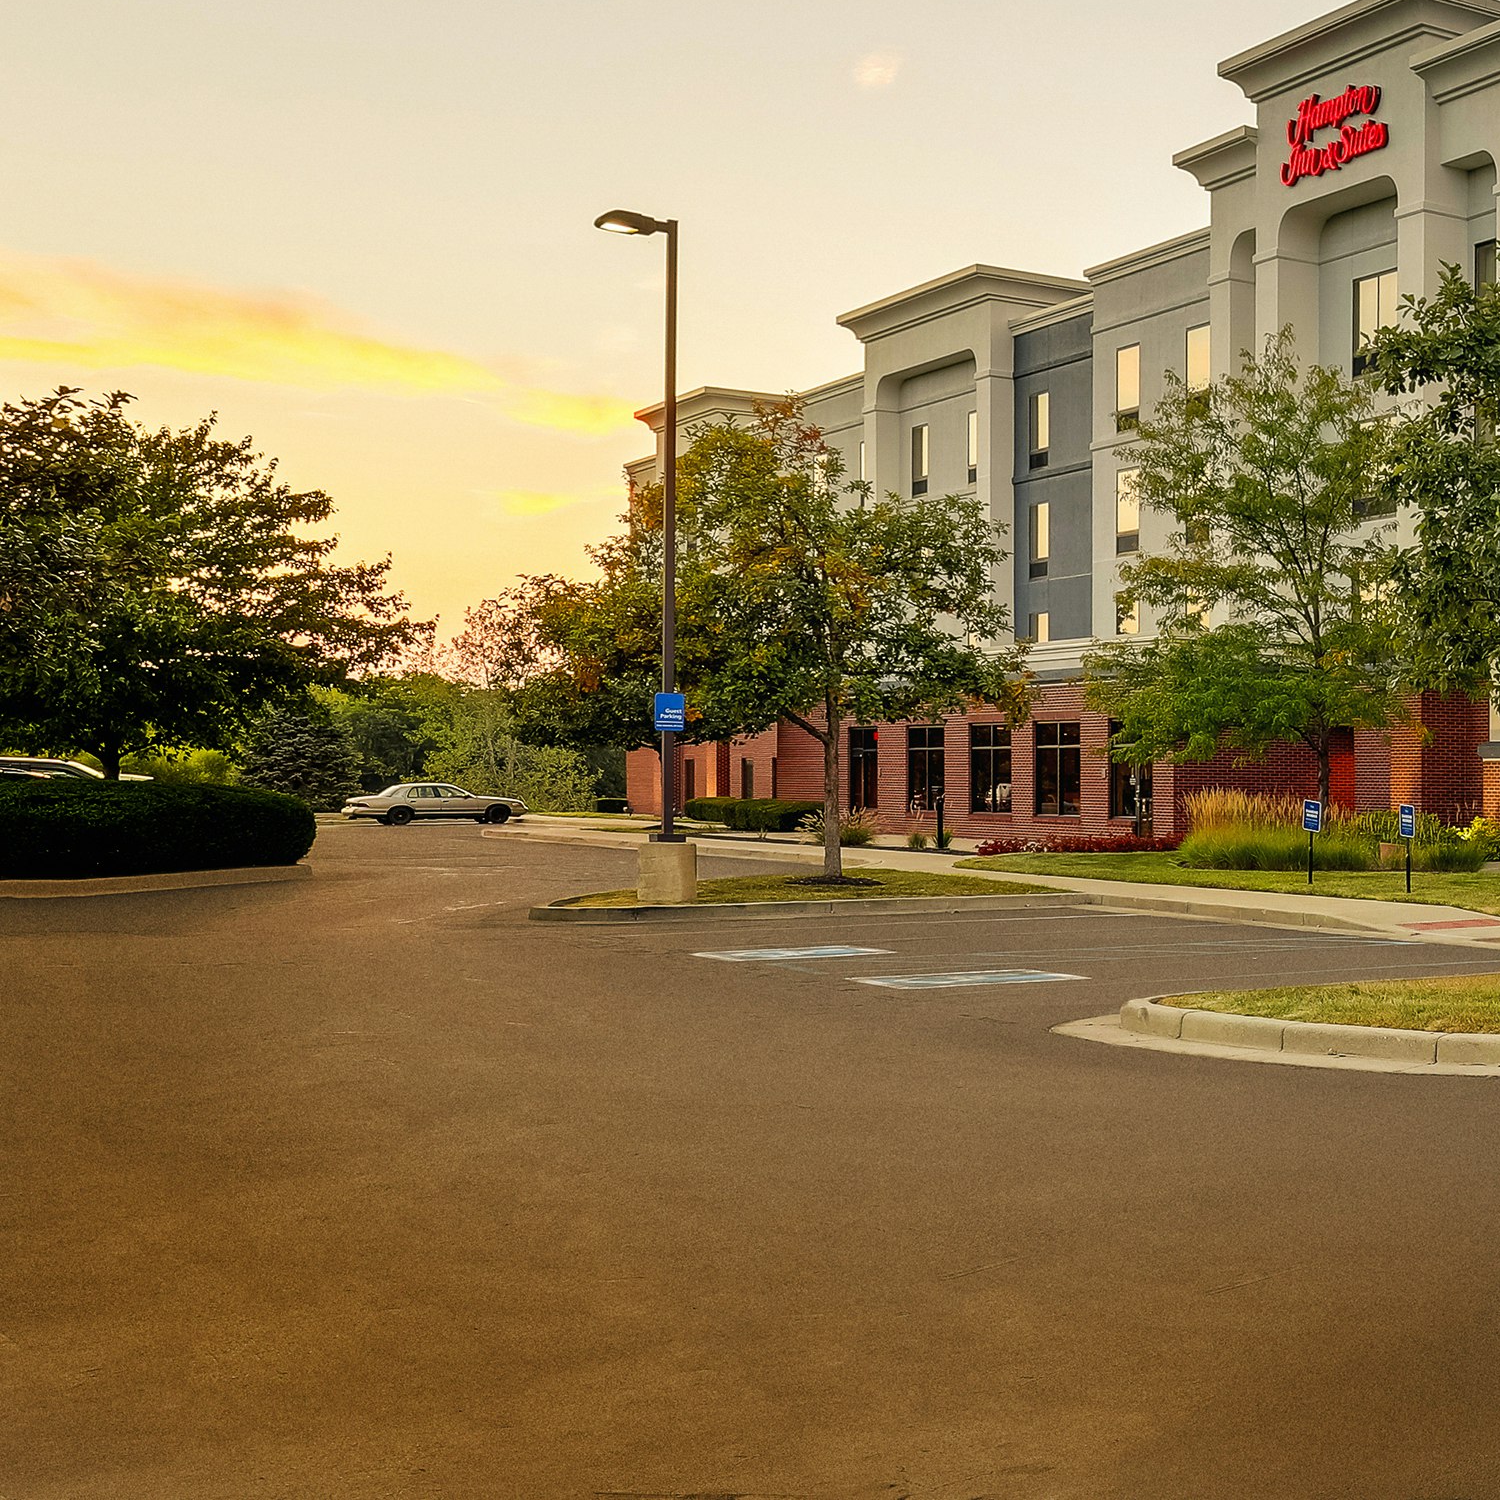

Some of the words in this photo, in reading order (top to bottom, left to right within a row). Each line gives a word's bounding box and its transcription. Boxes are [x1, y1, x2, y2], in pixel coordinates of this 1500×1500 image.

[1286, 84, 1382, 149] Hampton
[1280, 144, 1326, 187] Inn
[1335, 119, 1389, 164] Suites
